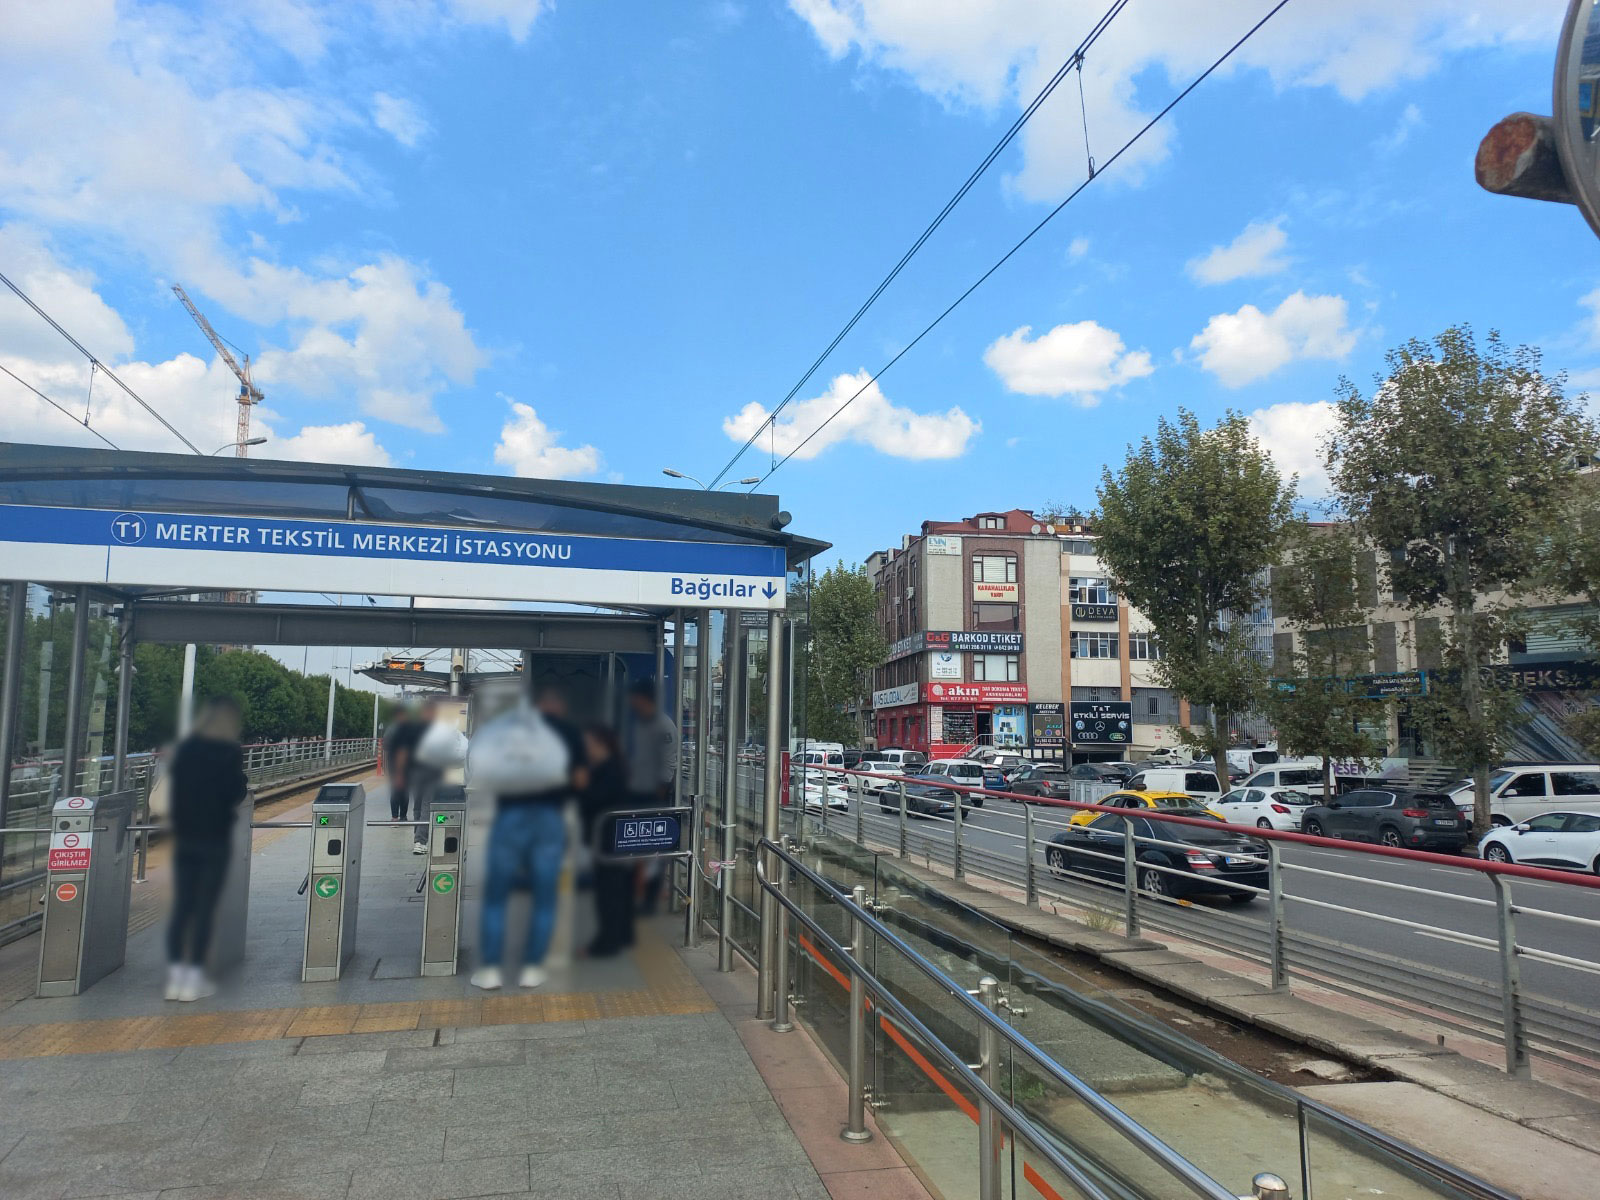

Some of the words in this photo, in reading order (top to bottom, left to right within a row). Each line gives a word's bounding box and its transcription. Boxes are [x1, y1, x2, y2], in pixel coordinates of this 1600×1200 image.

[116, 521, 141, 538] T1
[156, 523, 250, 544] MERTER
[258, 528, 345, 549] TEKSTİL
[352, 533, 448, 554] MERKEZİ
[455, 535, 572, 560] İSTASYONU
[671, 577, 757, 601] Bağcılar
[1088, 607, 1115, 615] DEVA
[951, 633, 989, 643] BARKOD
[948, 686, 980, 696] akın
[54, 851, 86, 860] ÇIKIŞTIR
[51, 859, 88, 867] GİRİLMEZ
